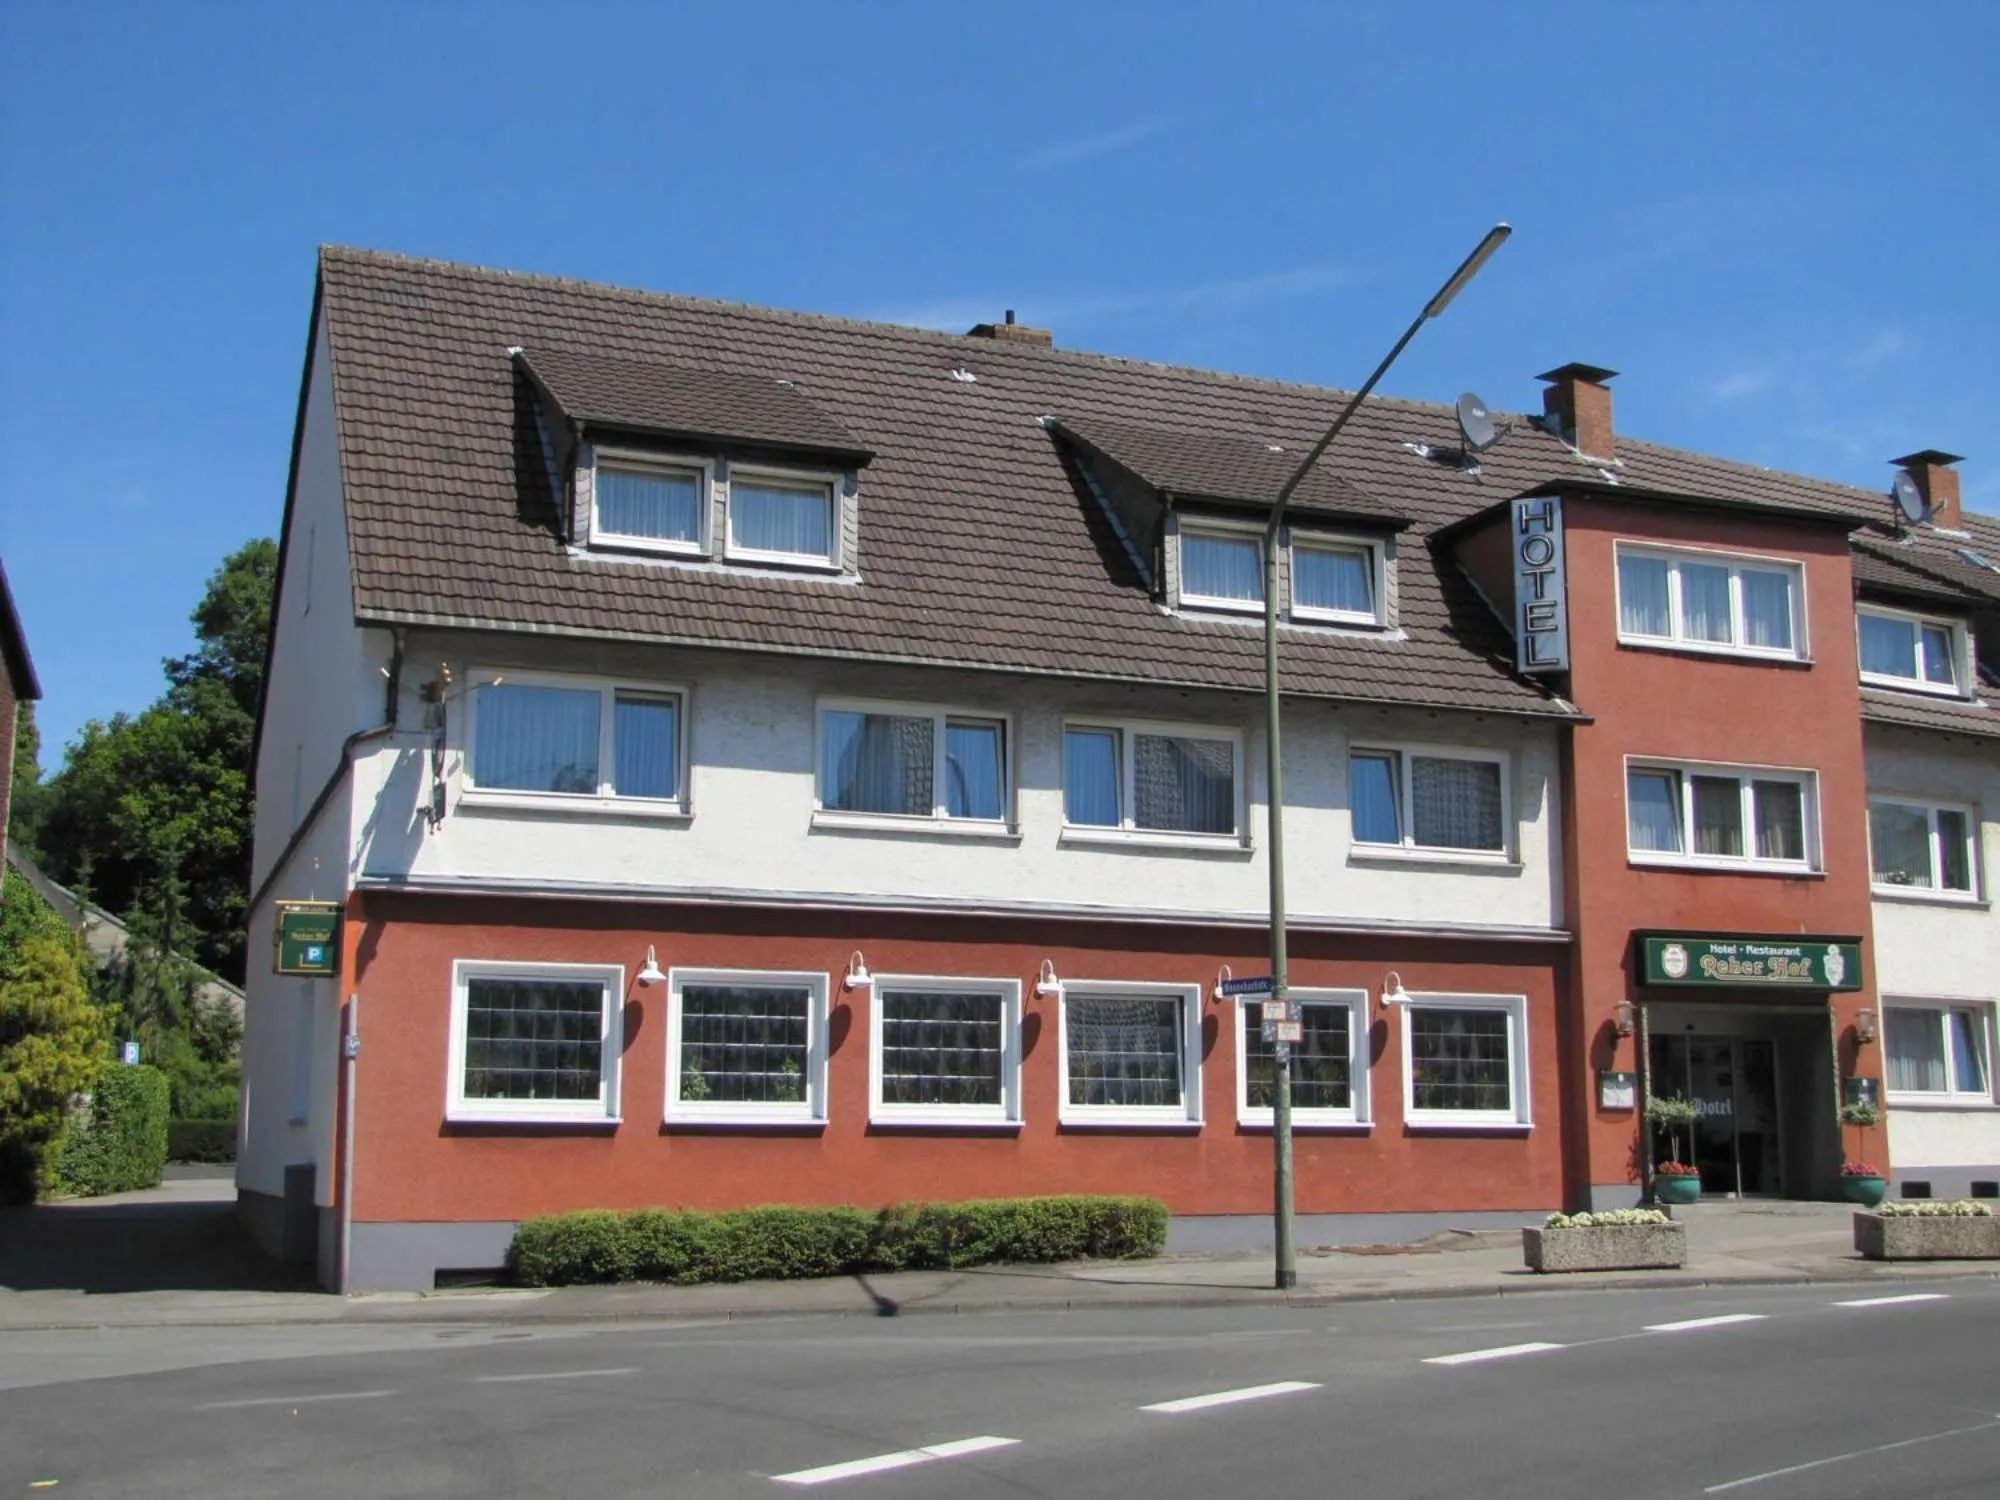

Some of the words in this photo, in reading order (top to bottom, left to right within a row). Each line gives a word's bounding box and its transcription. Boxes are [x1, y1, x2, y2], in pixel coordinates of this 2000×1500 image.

[1519, 502, 1561, 666] HOTEL
[1710, 944, 1737, 954] Hotel
[1746, 944, 1801, 956] Restaurant
[1768, 956, 1812, 980] Hof
